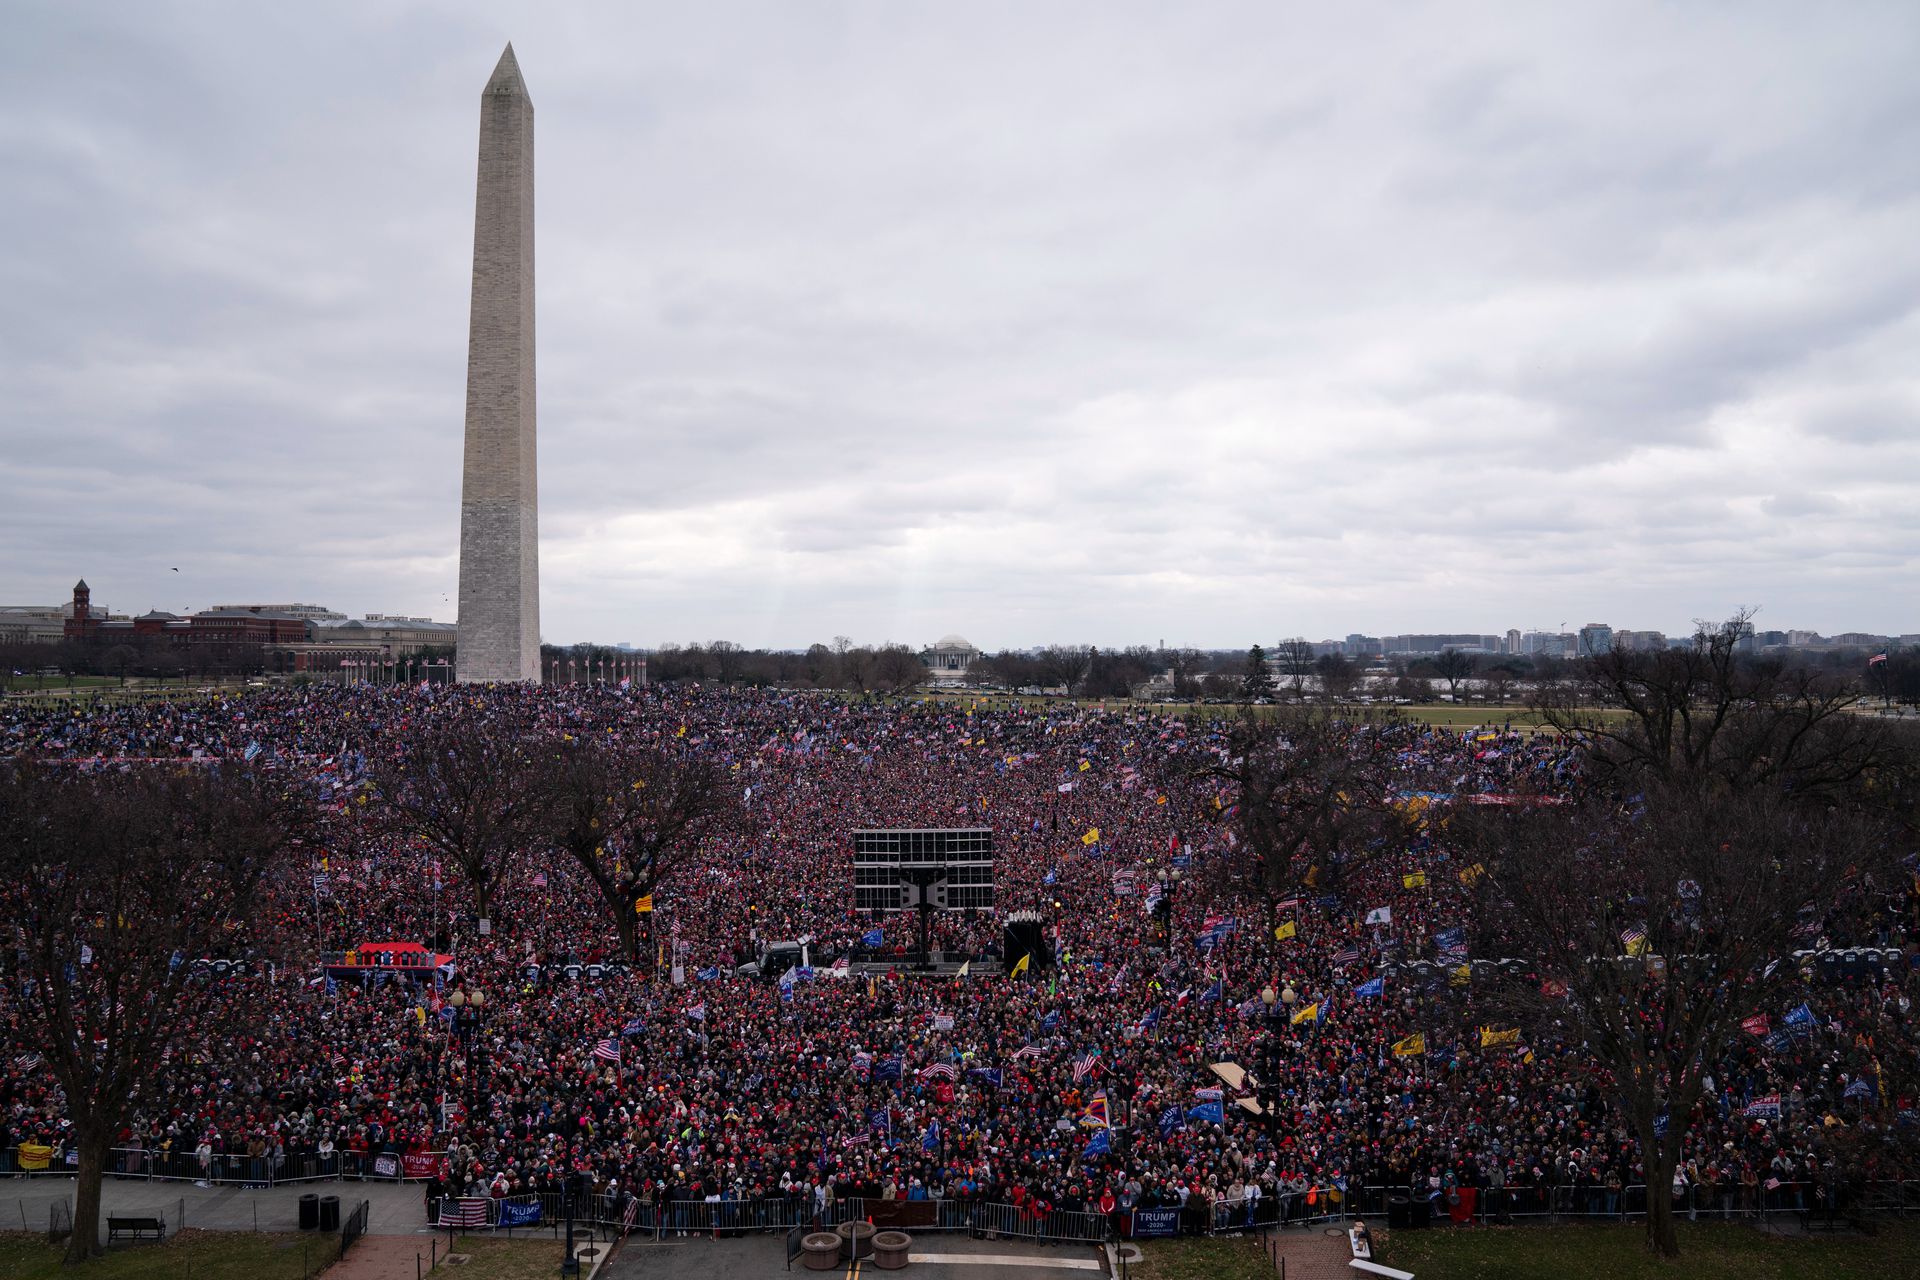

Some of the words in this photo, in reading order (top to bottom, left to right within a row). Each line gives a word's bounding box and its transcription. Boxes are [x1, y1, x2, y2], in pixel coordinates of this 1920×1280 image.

[404, 1155, 434, 1166] TRUMP
[506, 1204, 540, 1216] TRUMP
[1138, 1212, 1176, 1222] TRUMP
